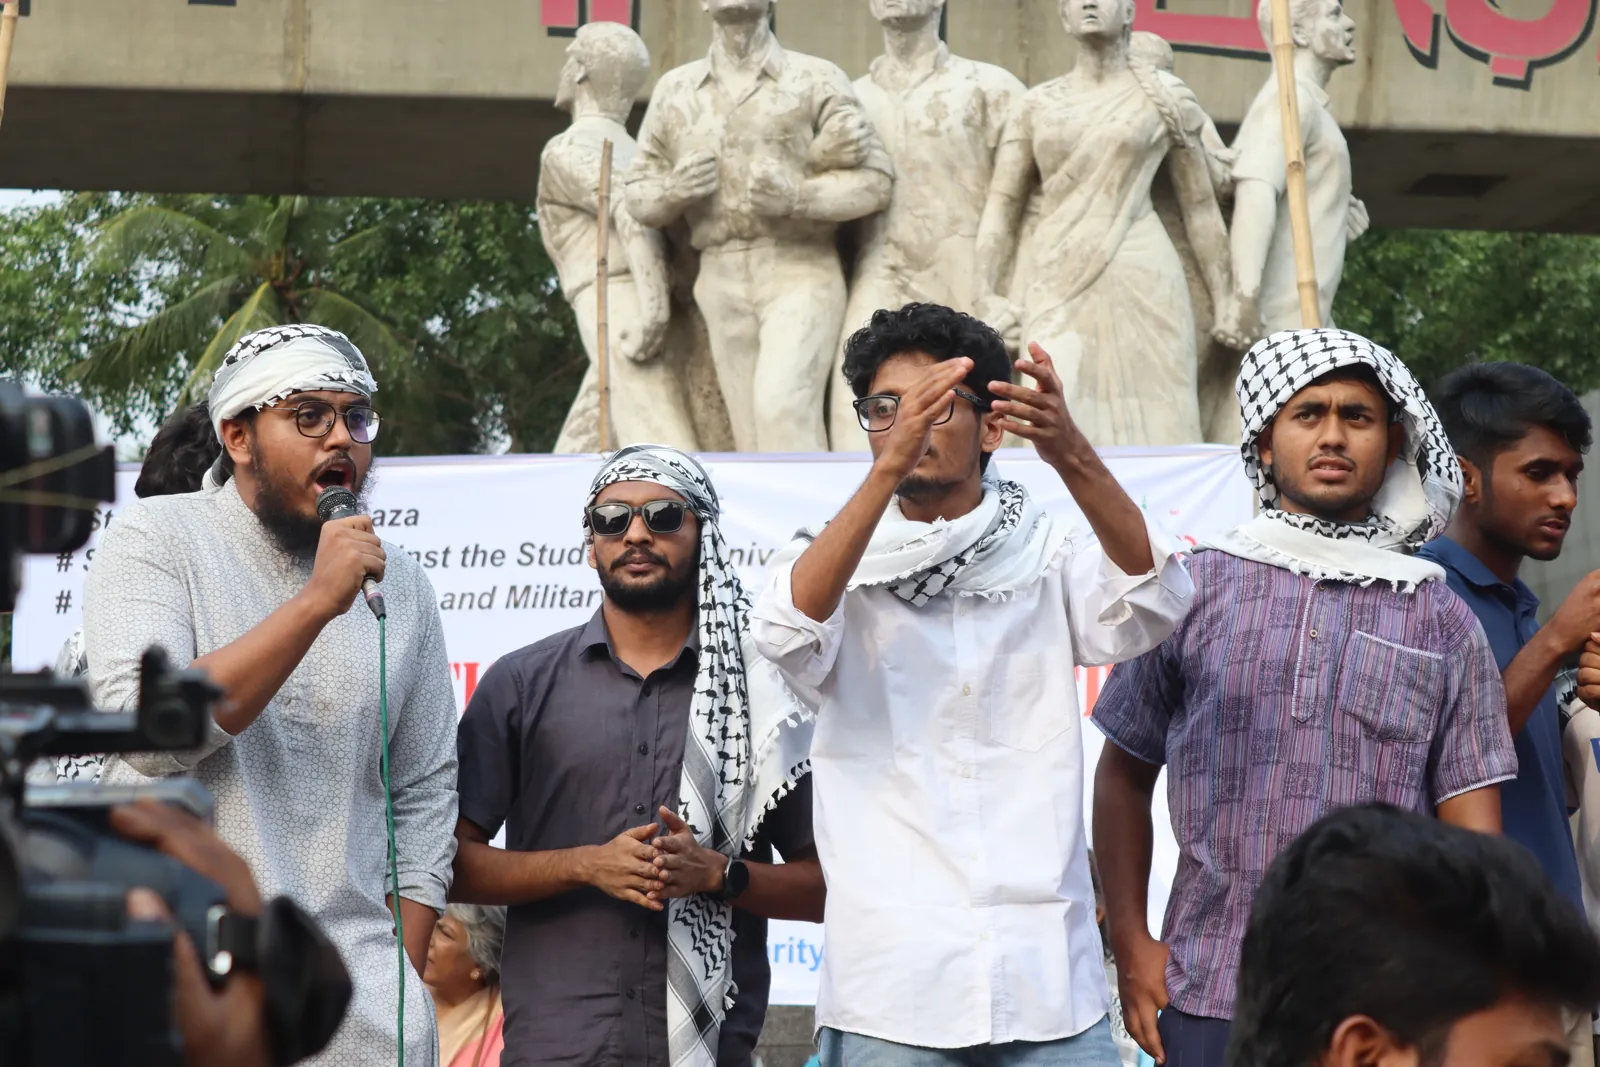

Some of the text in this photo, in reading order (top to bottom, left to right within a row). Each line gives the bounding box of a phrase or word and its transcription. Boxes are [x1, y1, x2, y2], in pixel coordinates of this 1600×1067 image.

[460, 543, 506, 568] the
[55, 589, 72, 614] #
[440, 585, 497, 610] and
[767, 936, 824, 972] rity
